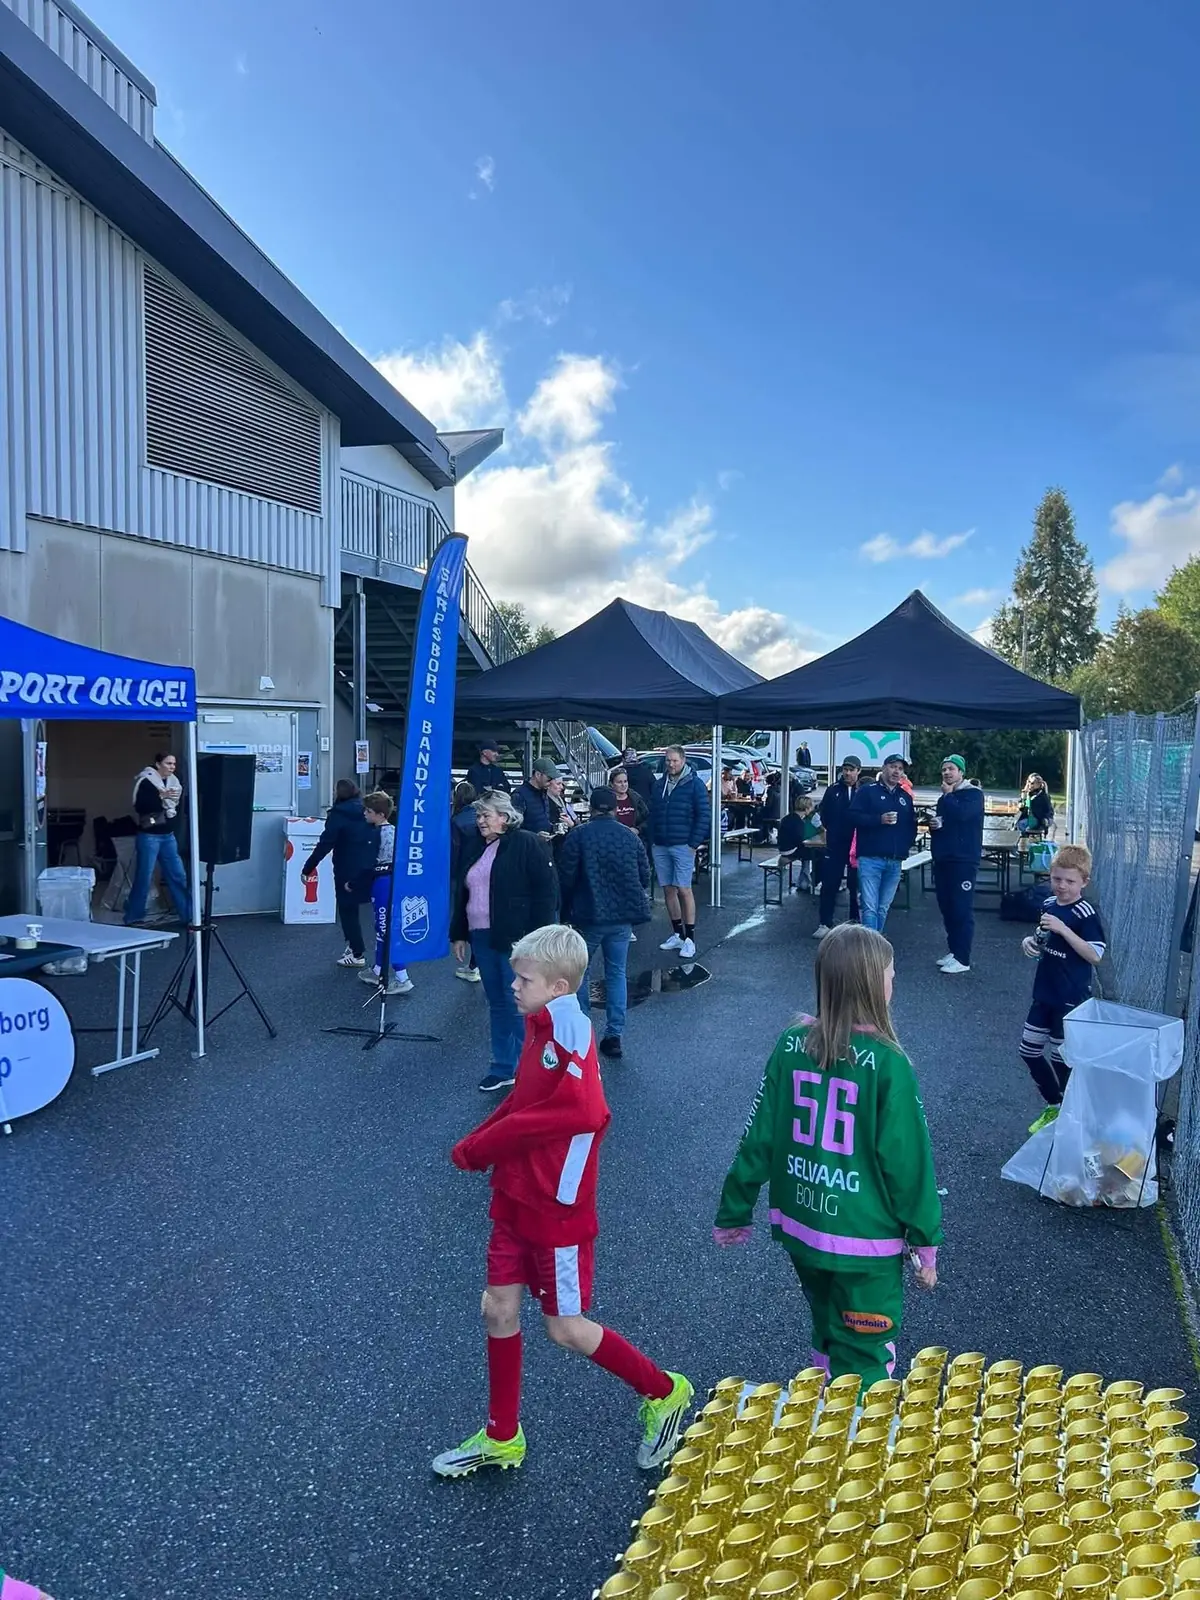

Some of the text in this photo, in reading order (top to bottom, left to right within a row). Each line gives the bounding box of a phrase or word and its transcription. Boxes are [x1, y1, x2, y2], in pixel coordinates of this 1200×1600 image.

[424, 568, 450, 704] SARPSBORG
[0, 670, 188, 708] PORT ON ICE!
[407, 720, 433, 876] BANDYKLUBB
[0, 1007, 49, 1035] borg
[784, 1035, 876, 1071] SNYA
[792, 1069, 859, 1156] 56
[787, 1154, 860, 1193] SELVAAG
[796, 1183, 840, 1216] BOLIG
